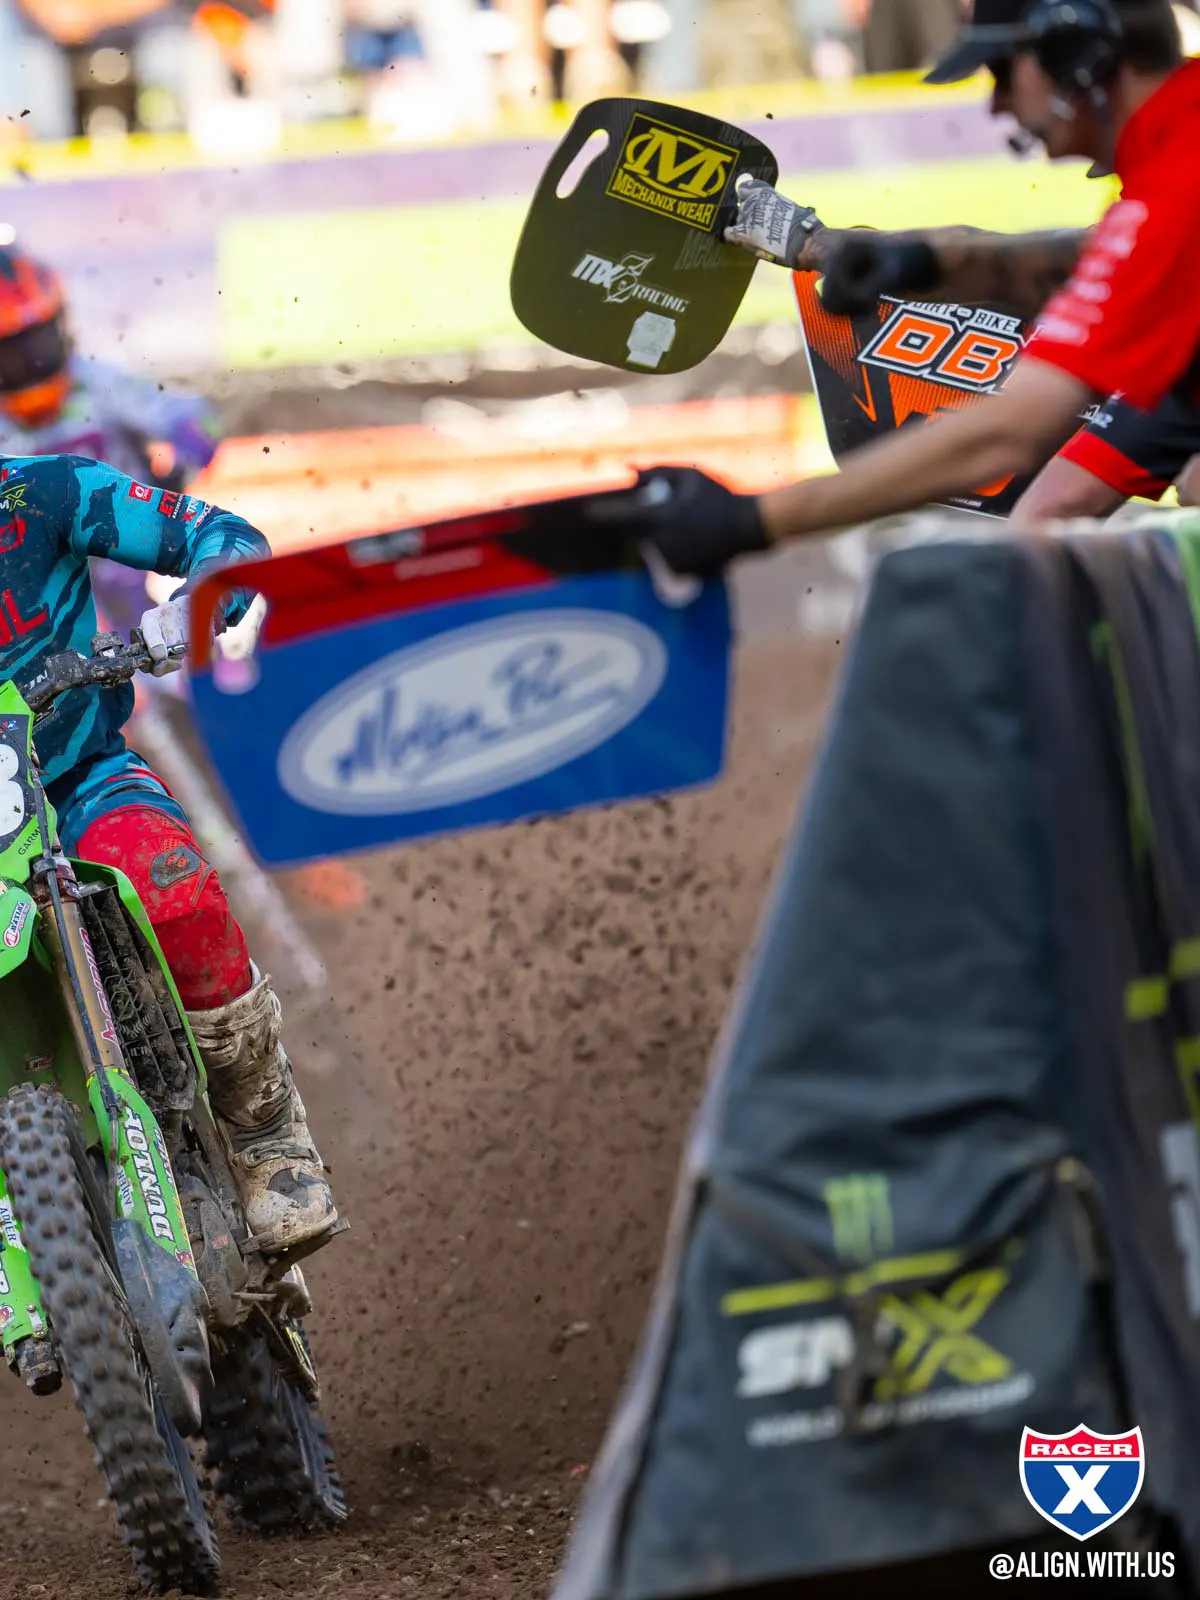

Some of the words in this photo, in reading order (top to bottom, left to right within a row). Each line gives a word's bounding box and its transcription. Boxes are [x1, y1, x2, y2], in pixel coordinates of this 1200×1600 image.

[612, 169, 674, 212] MECHANIX
[676, 202, 716, 225] WEAR
[631, 284, 689, 313] RACING
[17, 824, 41, 856] GARM
